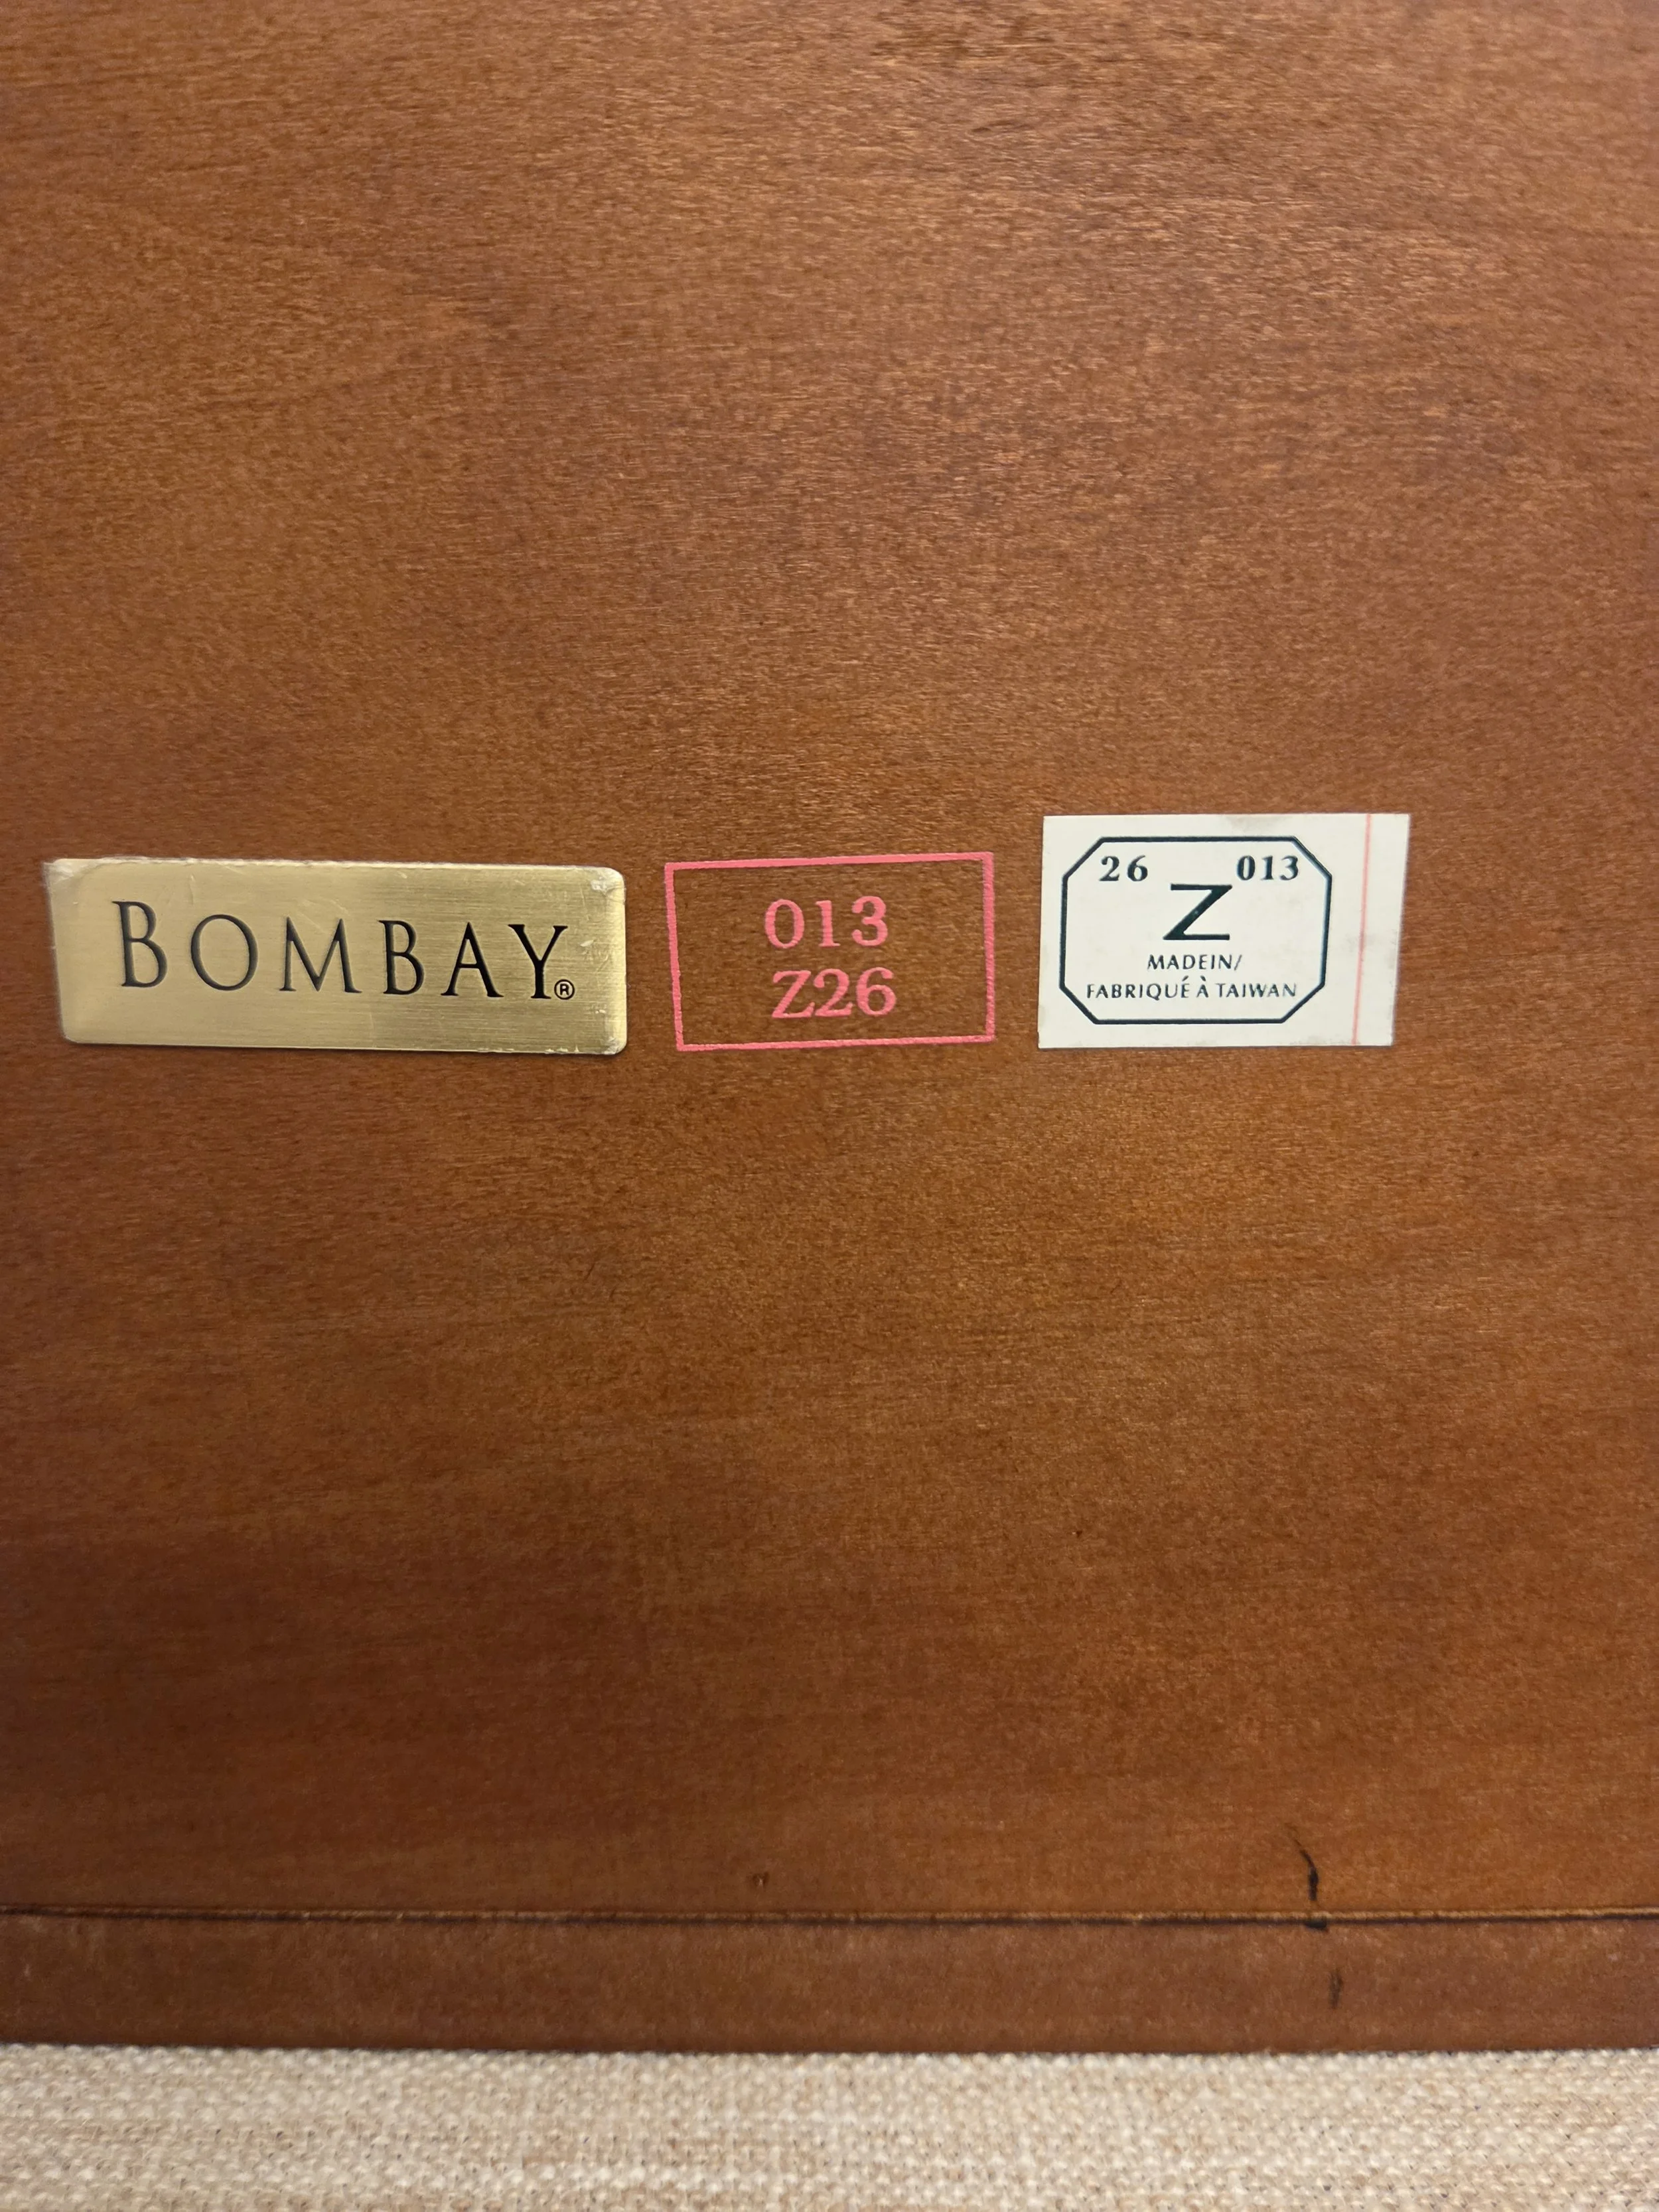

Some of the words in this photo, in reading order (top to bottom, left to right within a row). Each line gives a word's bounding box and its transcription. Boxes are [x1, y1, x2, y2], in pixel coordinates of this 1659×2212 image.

[1098, 855, 1149, 882] 26
[1236, 855, 1299, 881] 013
[764, 896, 889, 949] 013
[1162, 883, 1233, 940] Z
[771, 966, 897, 1019] Z26
[1086, 976, 1190, 1001] FABRIQUÉ
[1196, 976, 1209, 998] À
[1215, 983, 1297, 998] TAIWAN
